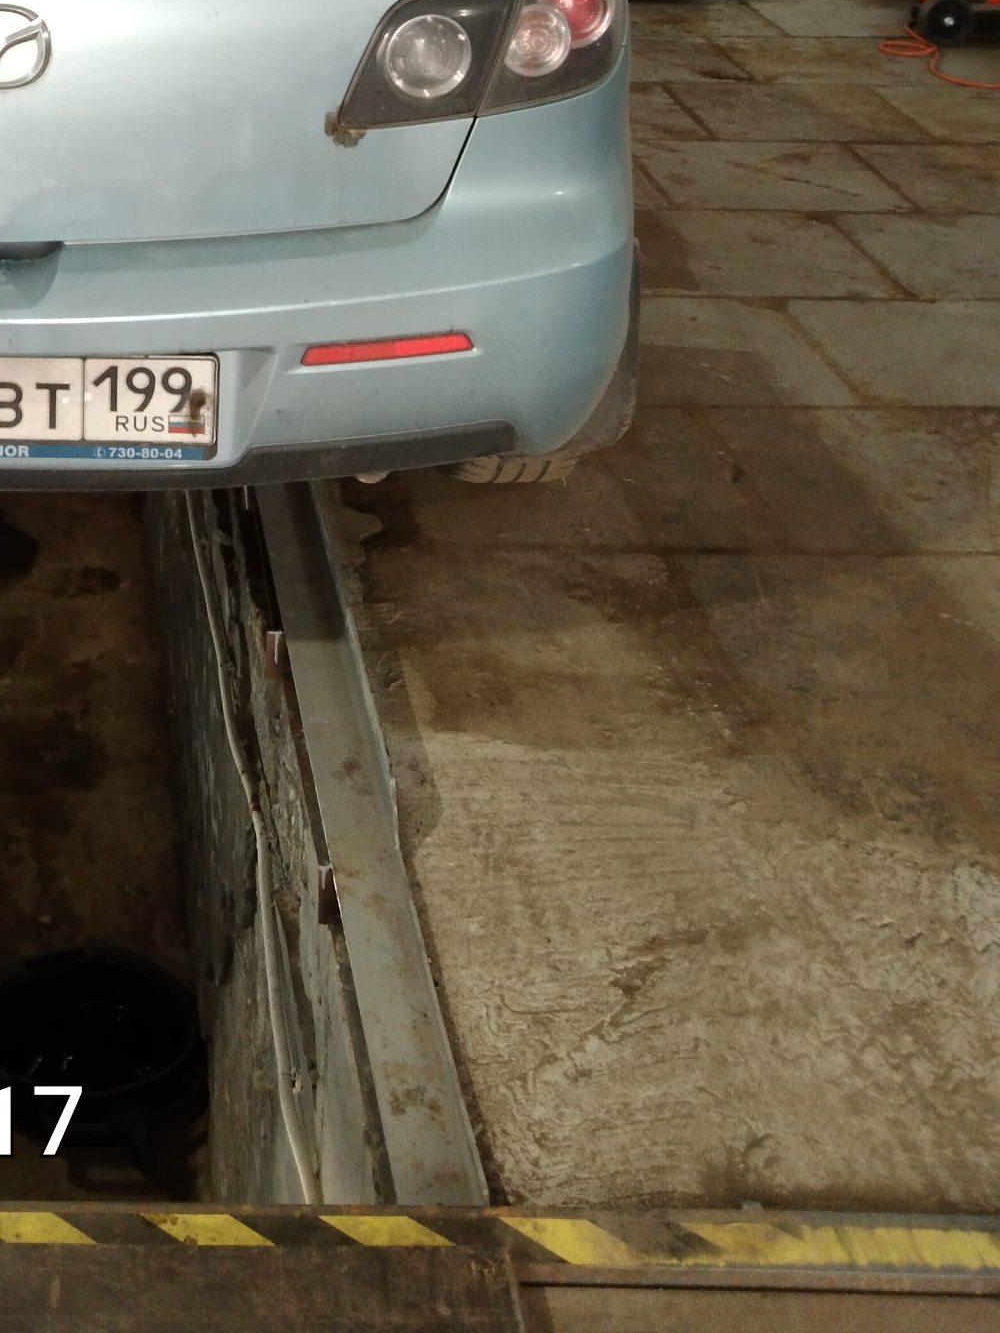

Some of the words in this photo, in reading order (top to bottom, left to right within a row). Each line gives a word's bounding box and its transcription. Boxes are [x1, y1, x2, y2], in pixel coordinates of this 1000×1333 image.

[92, 365, 193, 413] 199
[115, 415, 165, 432] RUS
[108, 447, 183, 459] 730-80-04
